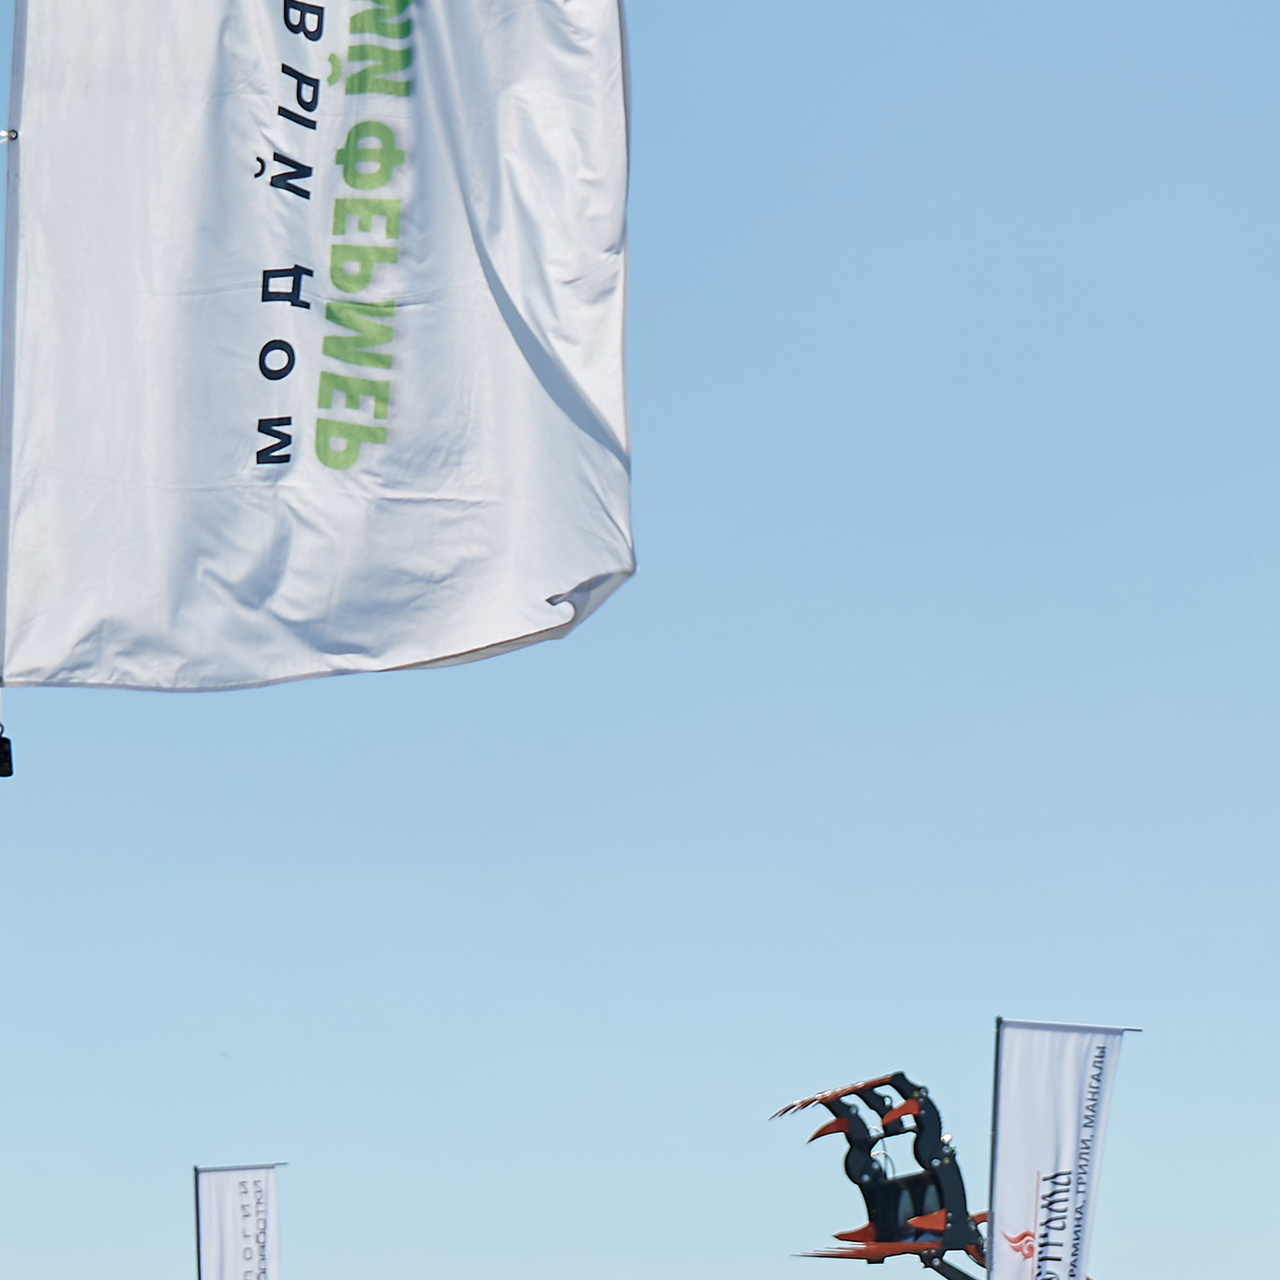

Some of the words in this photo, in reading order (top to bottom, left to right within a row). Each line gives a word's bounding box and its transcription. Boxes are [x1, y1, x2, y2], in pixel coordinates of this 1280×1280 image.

[256, 264, 314, 465] ДОМ
[315, 120, 405, 470] ФЕРМЕР
[1083, 1046, 1107, 1128] МАНГАЛЫ
